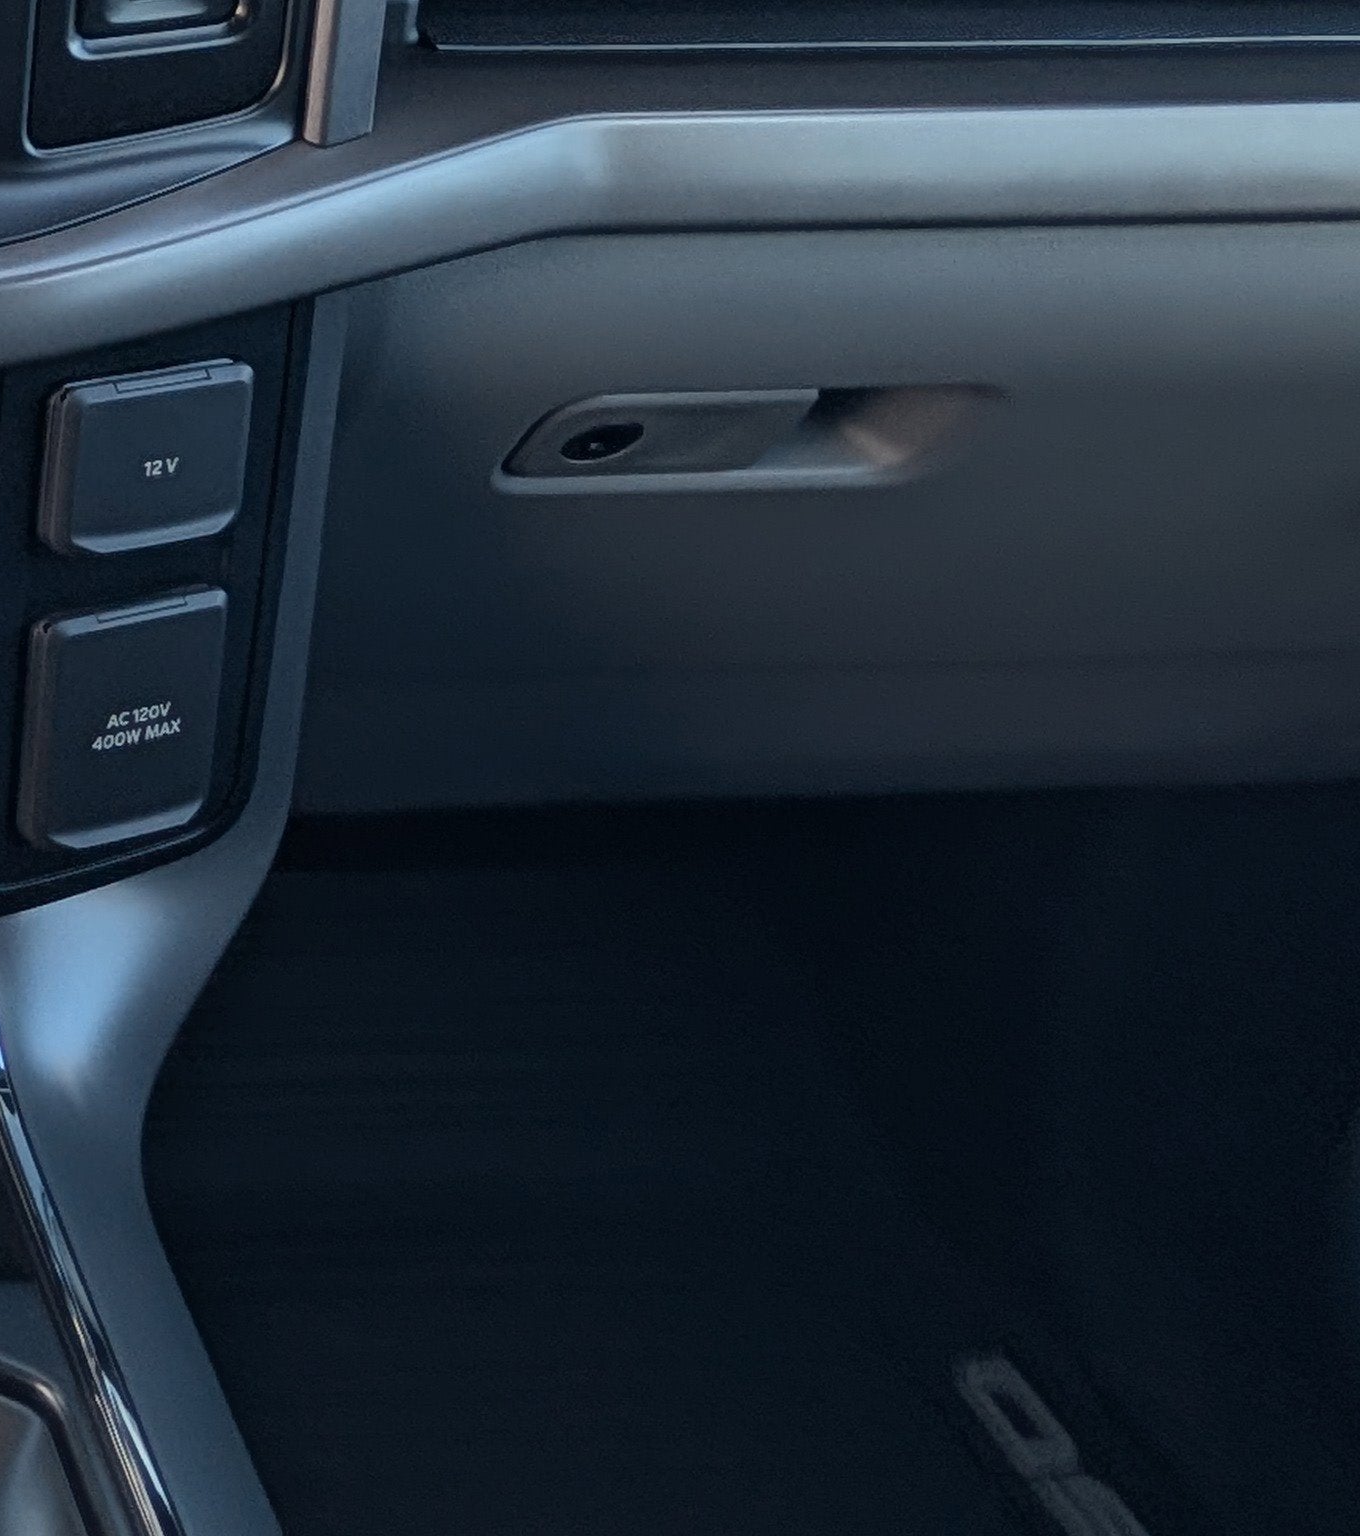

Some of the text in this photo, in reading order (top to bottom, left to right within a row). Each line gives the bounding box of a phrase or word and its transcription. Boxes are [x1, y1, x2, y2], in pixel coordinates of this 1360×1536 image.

[144, 456, 180, 477] 12 V
[106, 700, 172, 730] AC 120V
[91, 716, 182, 751] 400W MAX
